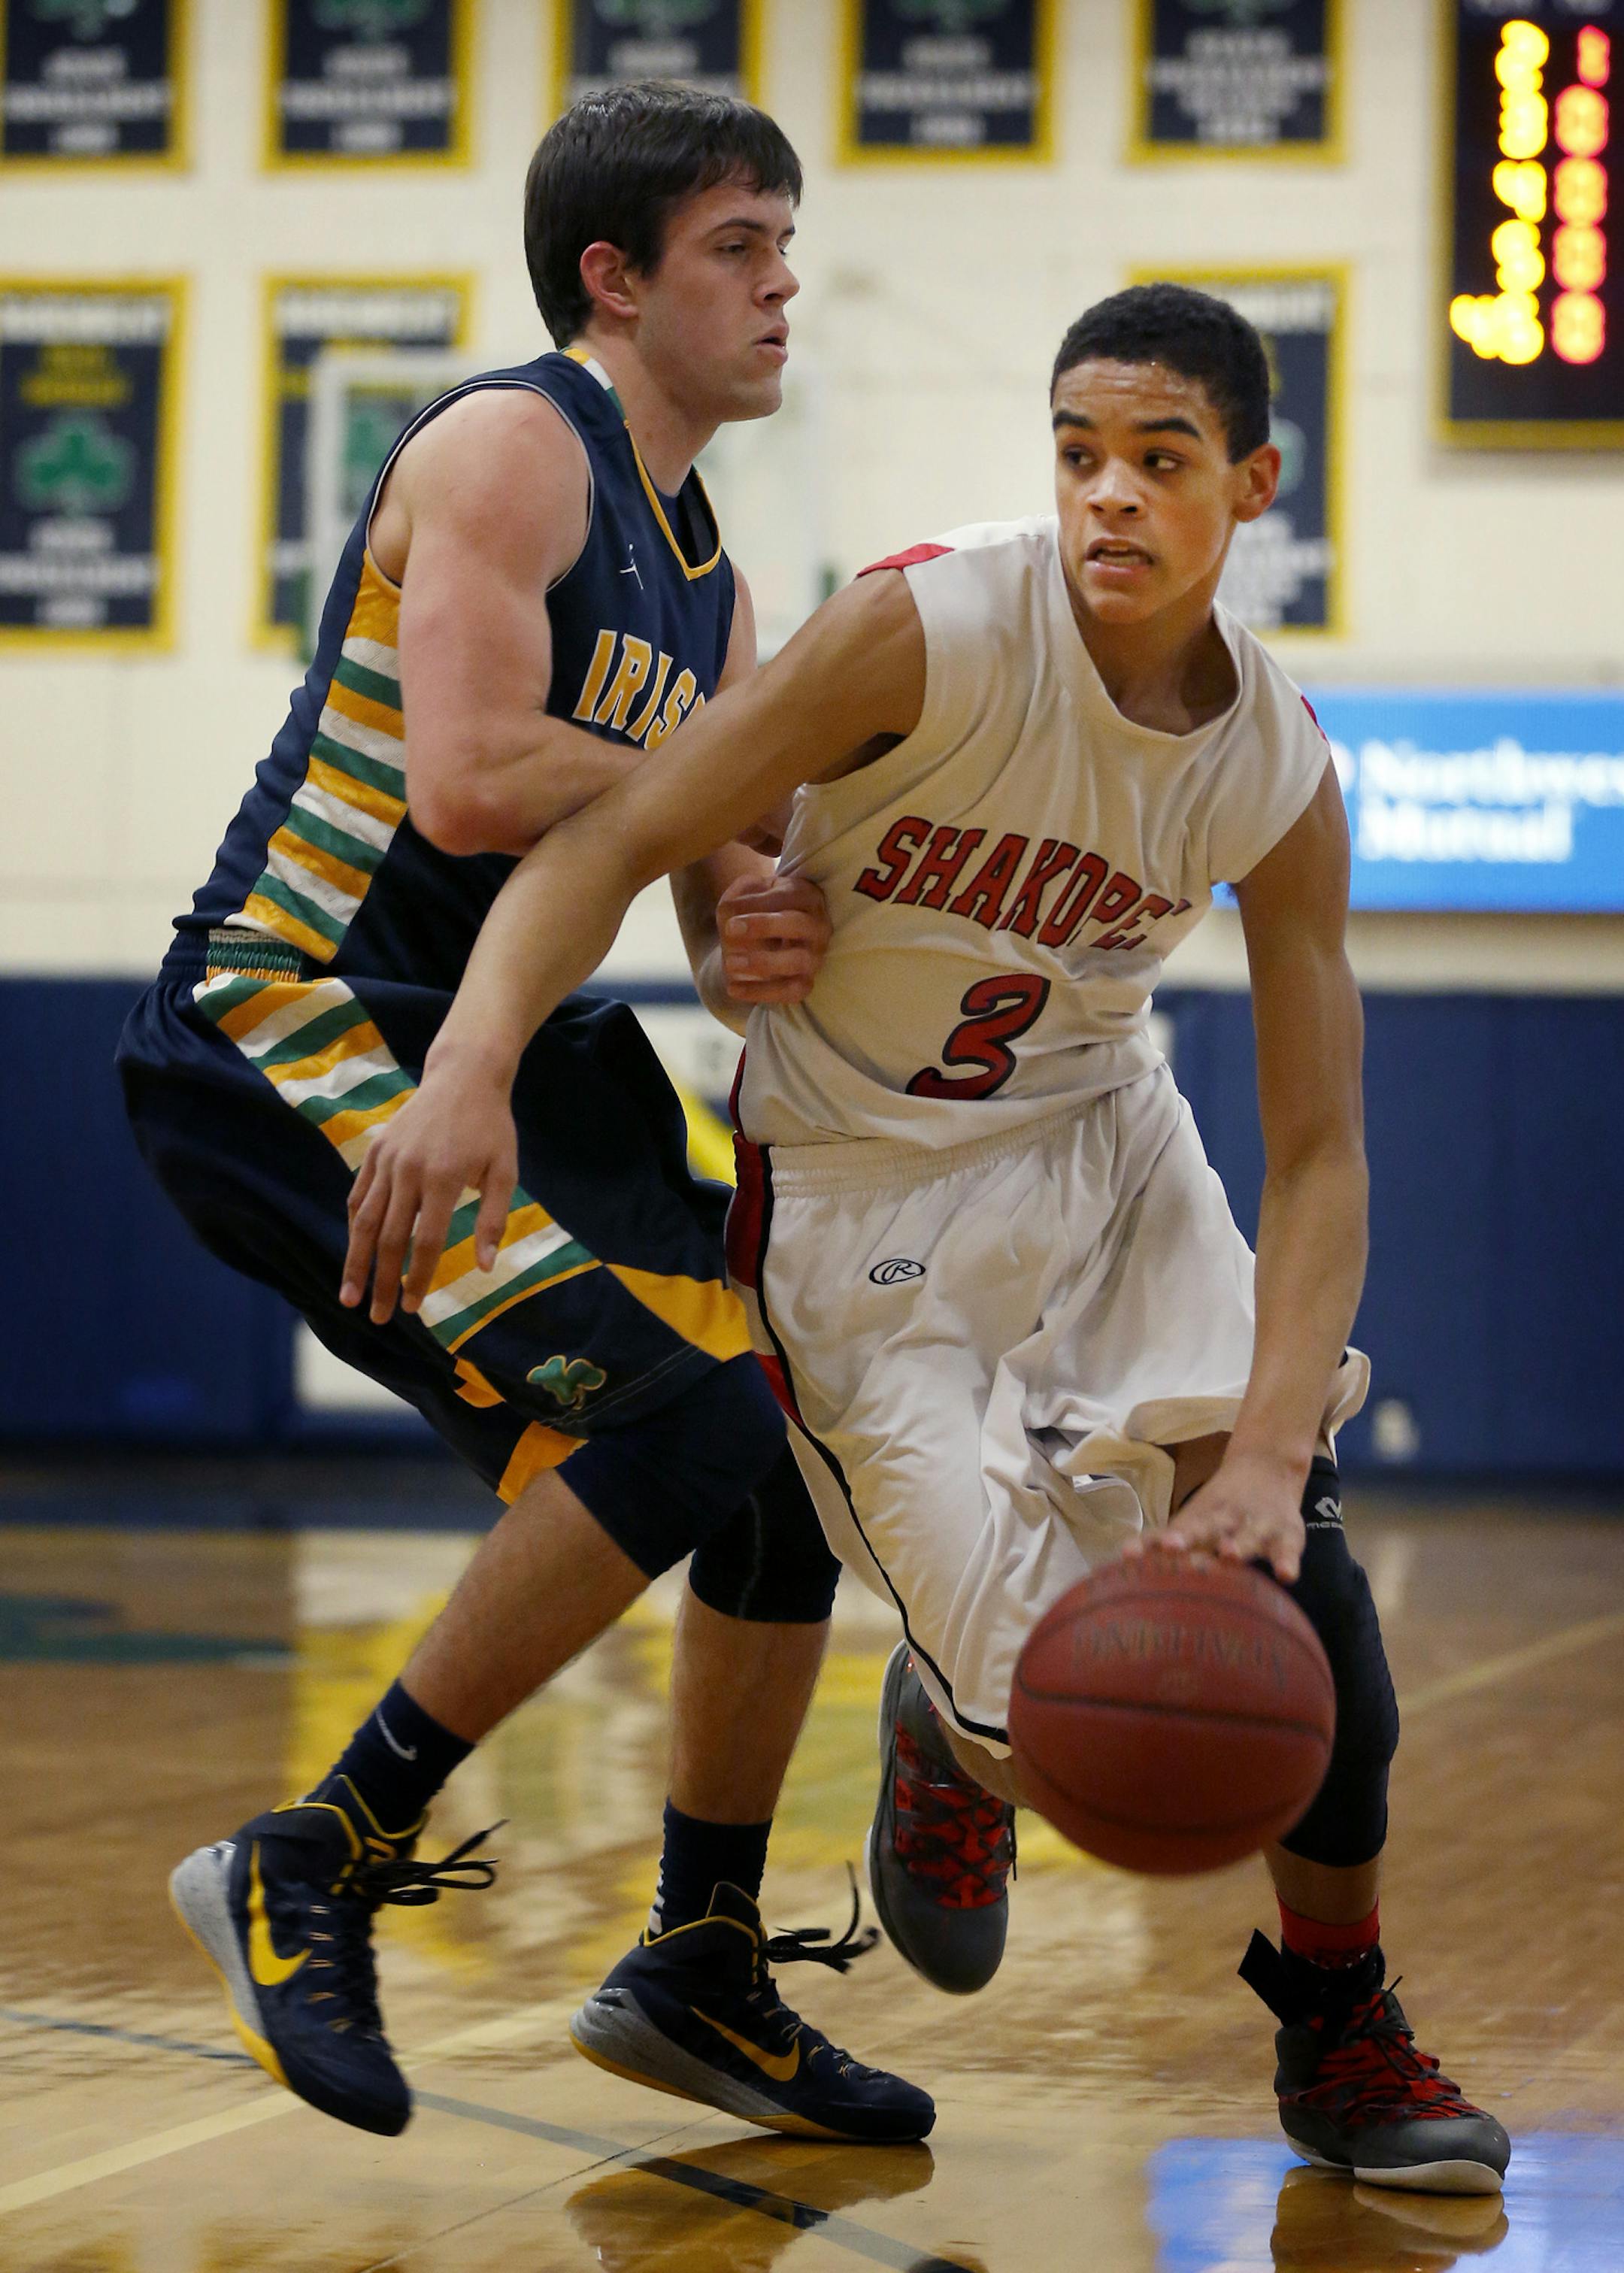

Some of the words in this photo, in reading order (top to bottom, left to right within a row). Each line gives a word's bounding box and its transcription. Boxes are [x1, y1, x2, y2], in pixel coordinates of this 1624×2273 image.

[571, 629, 706, 750] IRIS
[852, 816, 1192, 950] SHAKOPE
[905, 973, 1052, 1100] 3
